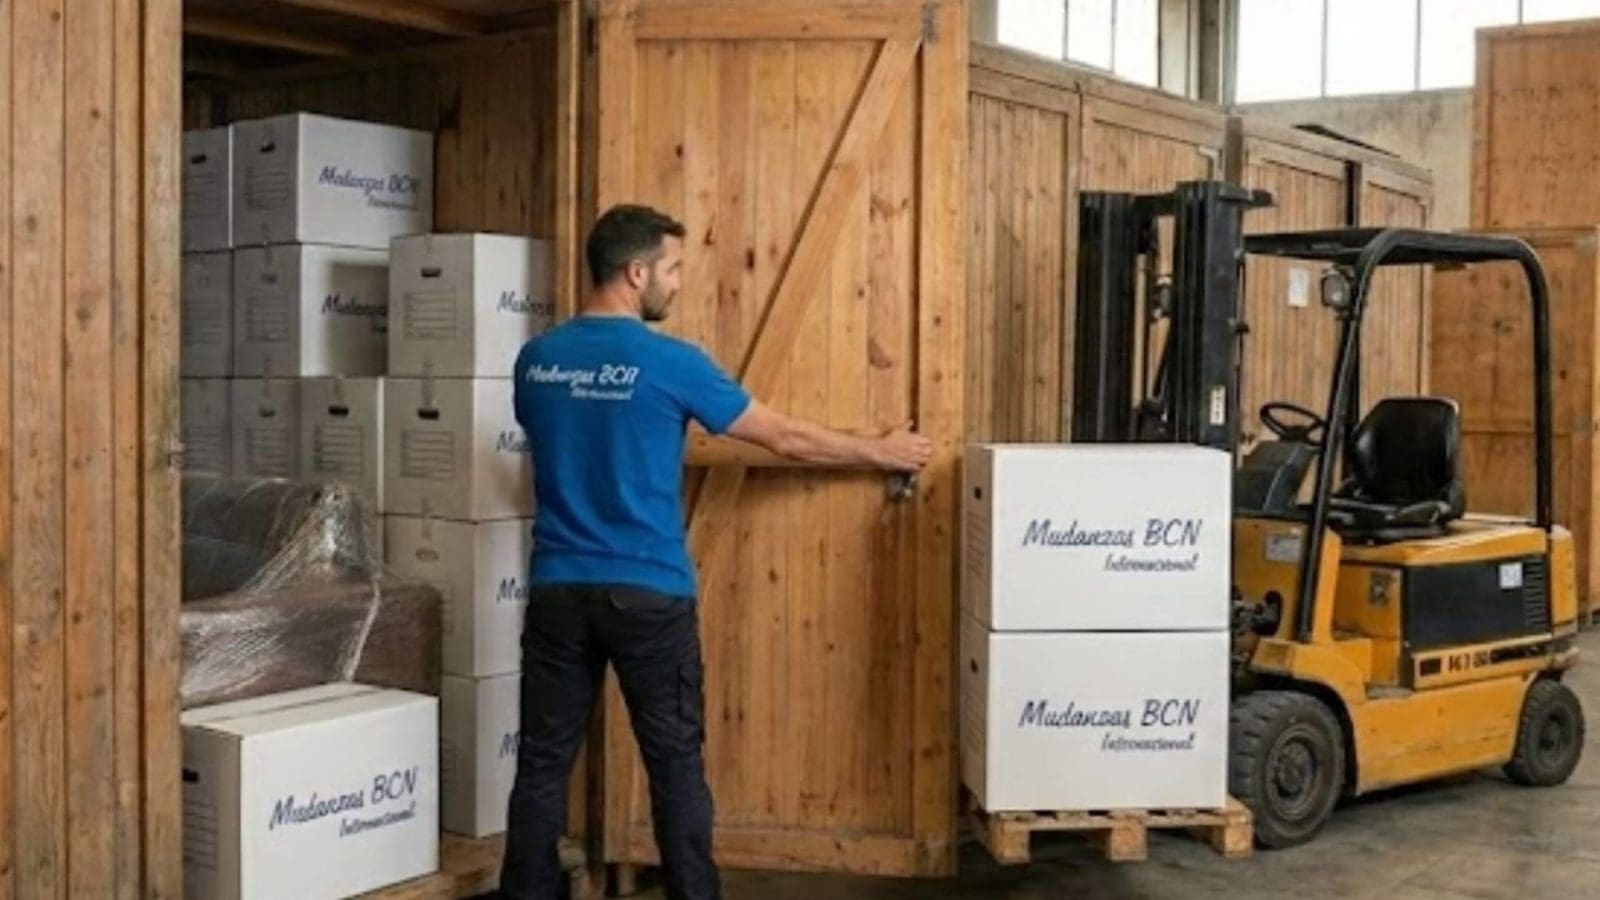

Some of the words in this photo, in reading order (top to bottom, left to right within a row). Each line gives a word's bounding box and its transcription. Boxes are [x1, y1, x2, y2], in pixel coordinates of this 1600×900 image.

[1022, 518, 1135, 547] Mudanzas
[1143, 518, 1203, 546] BCN
[1018, 700, 1131, 728] Mudanzas
[1140, 699, 1201, 726] BCN
[371, 766, 418, 804] BCN
